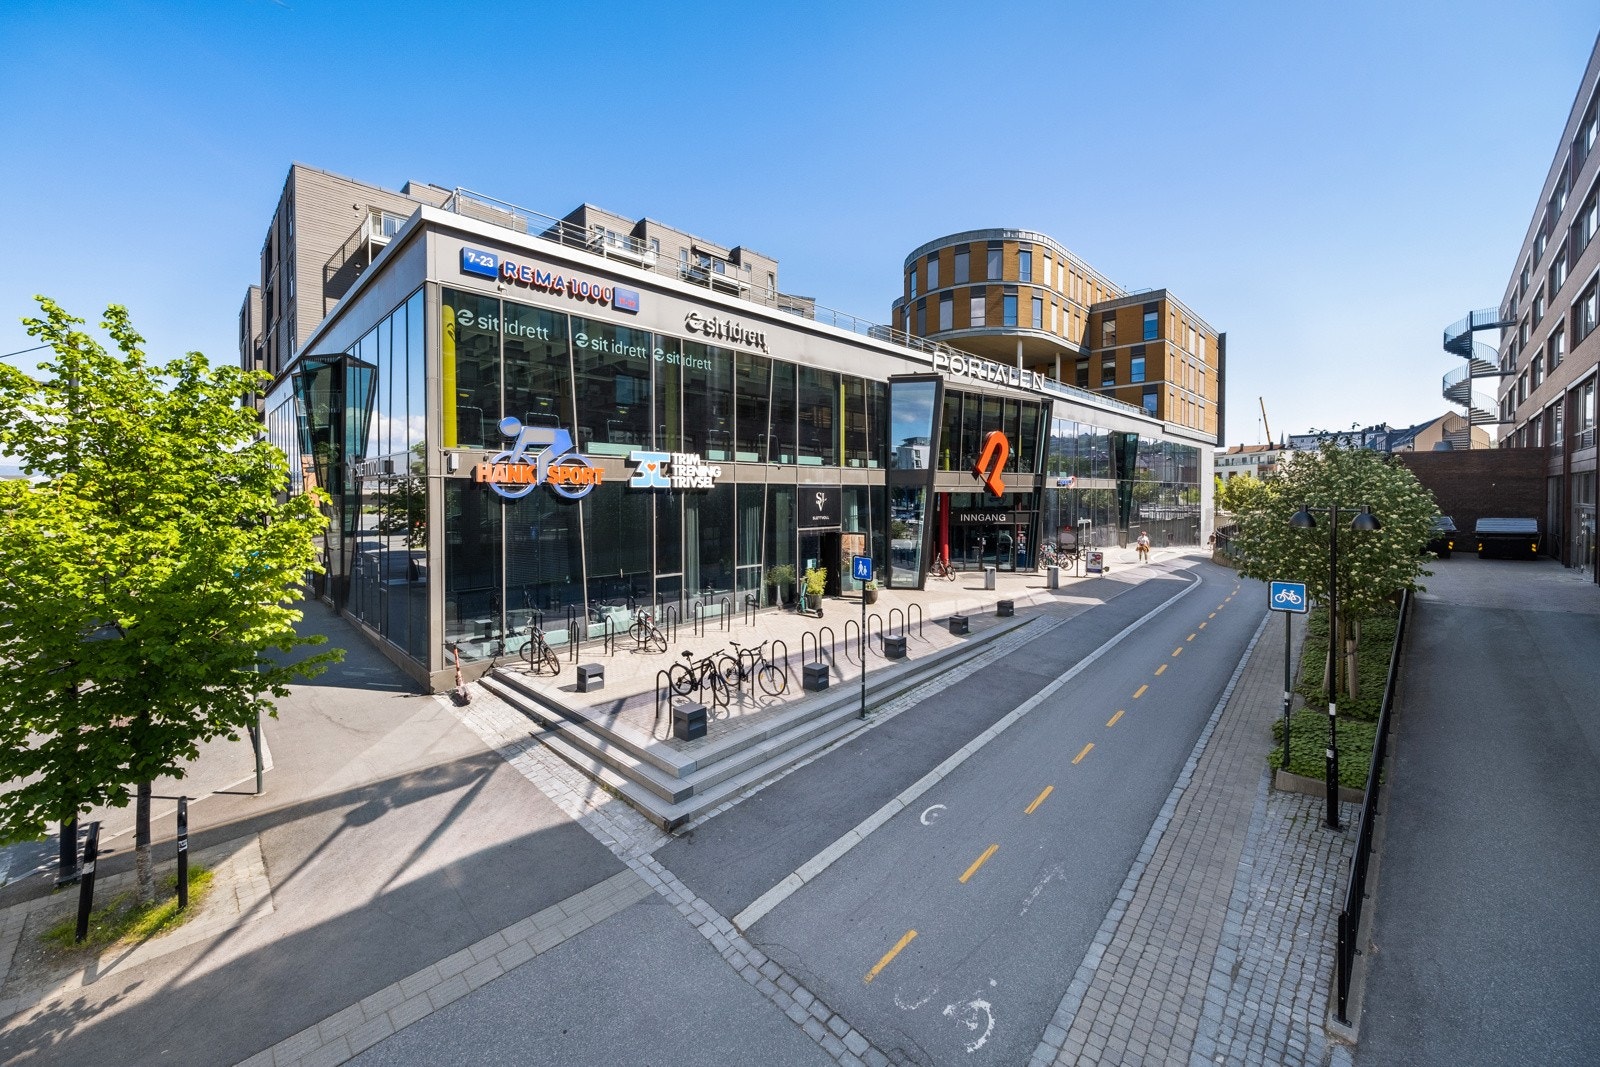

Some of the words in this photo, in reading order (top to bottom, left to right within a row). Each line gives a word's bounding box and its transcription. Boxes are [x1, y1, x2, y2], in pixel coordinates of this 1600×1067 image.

[468, 252, 494, 268] 7-23
[503, 260, 567, 290] REMA
[570, 277, 613, 301] 1000
[478, 314, 499, 332] sit
[504, 317, 549, 341] idrett
[706, 316, 727, 337] sit
[728, 320, 767, 345] idrett
[591, 337, 609, 352] sit
[611, 339, 647, 359] idrett
[666, 352, 681, 366] sit
[682, 353, 712, 371] idrett
[932, 351, 1045, 390] PORTALEN
[671, 452, 701, 465] TRIM
[475, 463, 536, 484] HANK
[547, 465, 605, 485] SPORT
[671, 464, 722, 477] TRENING
[671, 476, 715, 488] TRIVSEL
[960, 513, 1006, 522] INNGANG
